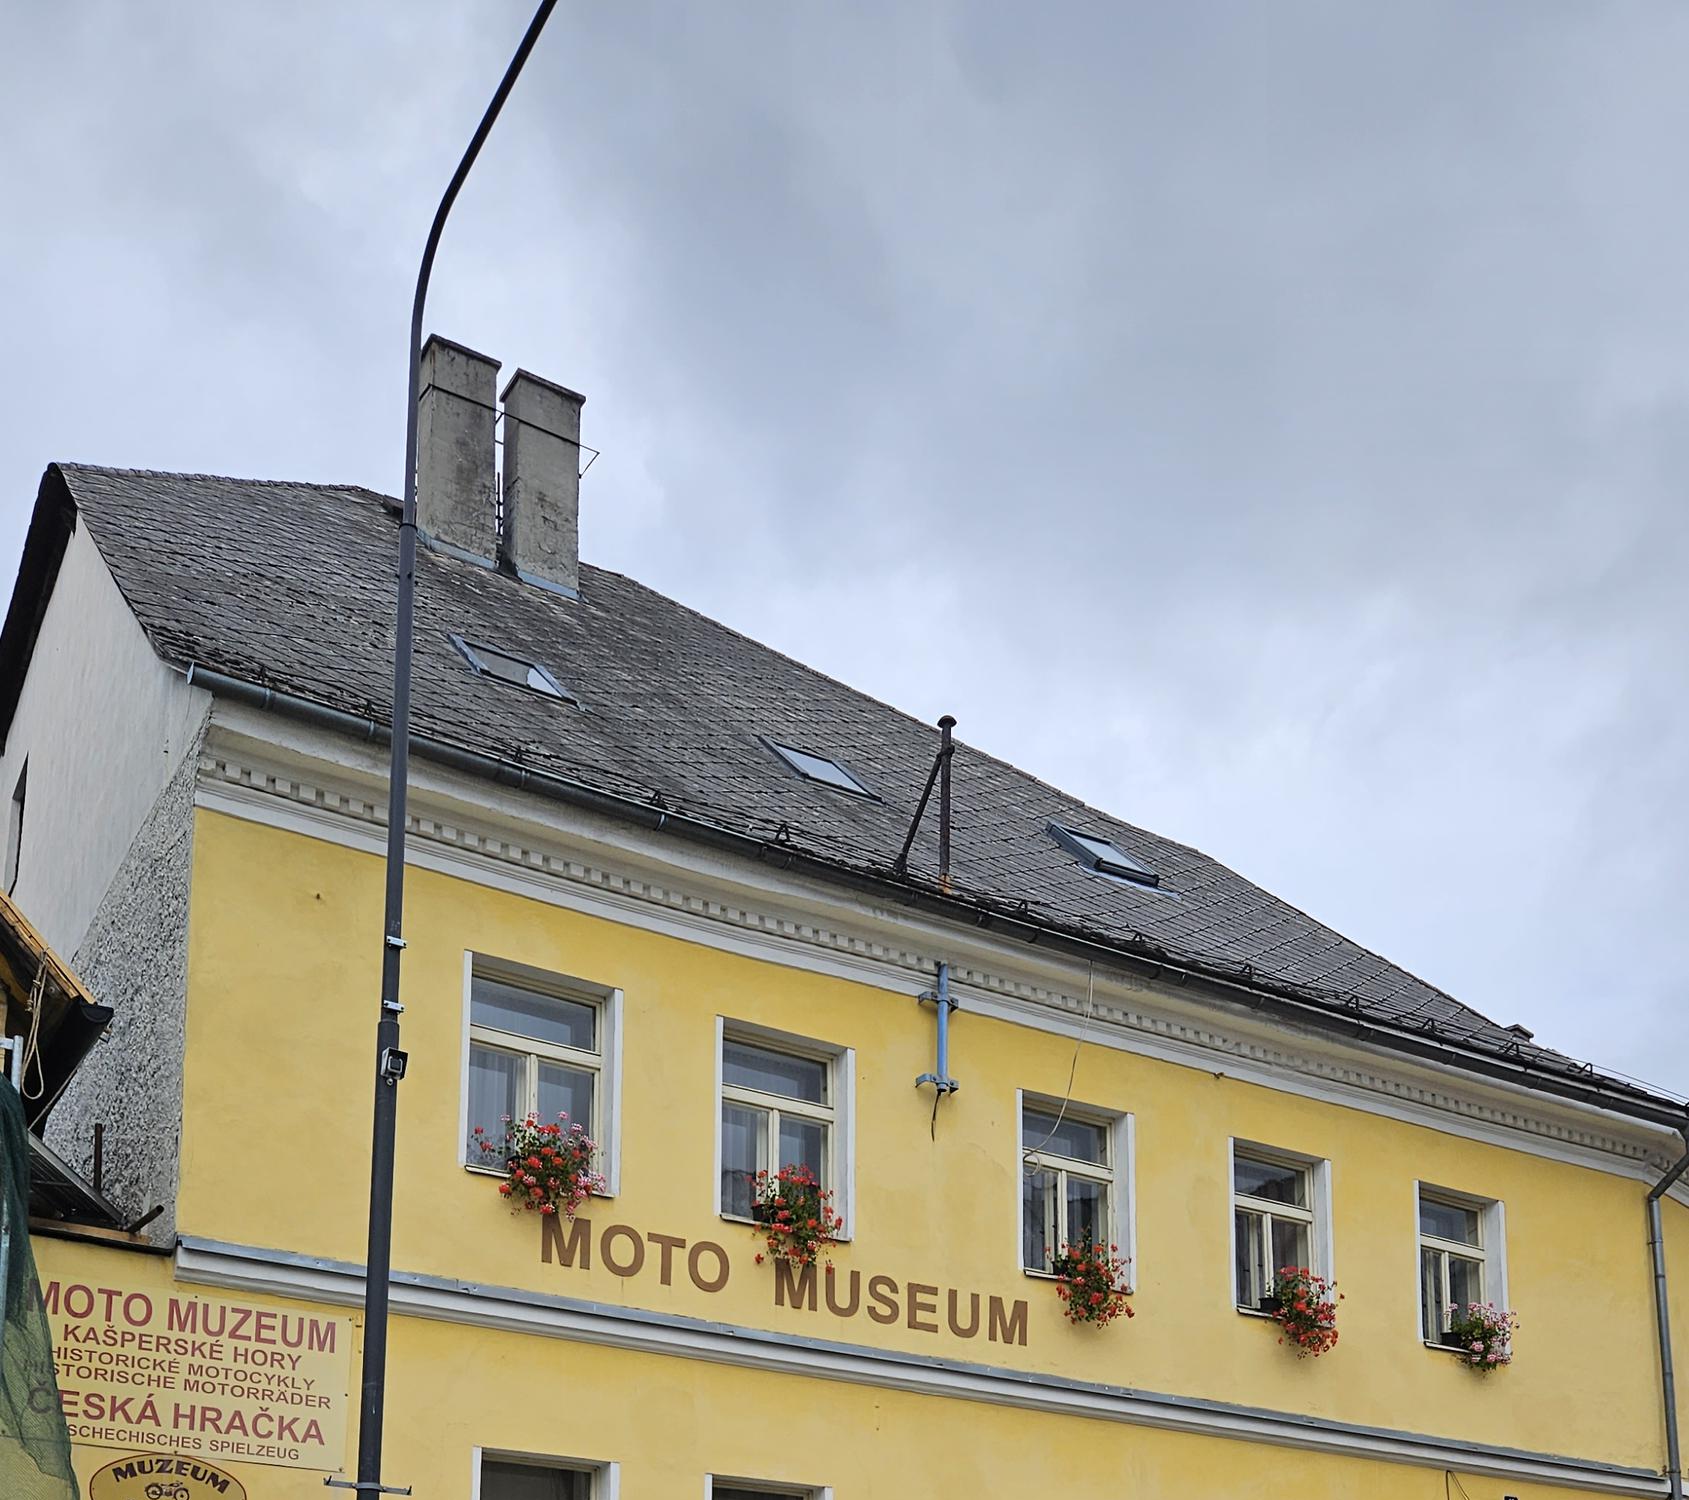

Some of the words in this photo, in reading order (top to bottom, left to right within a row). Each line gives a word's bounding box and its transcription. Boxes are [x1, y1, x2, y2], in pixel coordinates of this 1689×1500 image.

[541, 1212, 730, 1293] MOTO
[774, 1257, 1029, 1347] MUSEUM
[63, 1323, 224, 1361] KAŠPERSKÉ
[233, 1346, 302, 1371] HORY
[167, 1298, 336, 1354] MUZEUM
[51, 1346, 180, 1374] HISTORICKÉ
[188, 1363, 315, 1391] MOTOCYKLY
[183, 1378, 331, 1409] MOTORRÄDER
[67, 1423, 202, 1449] SCHECHISCHES
[209, 1439, 299, 1460] SPIELZEUG
[173, 1402, 325, 1446] HRAČKA
[112, 1459, 230, 1494] MUZEUM
